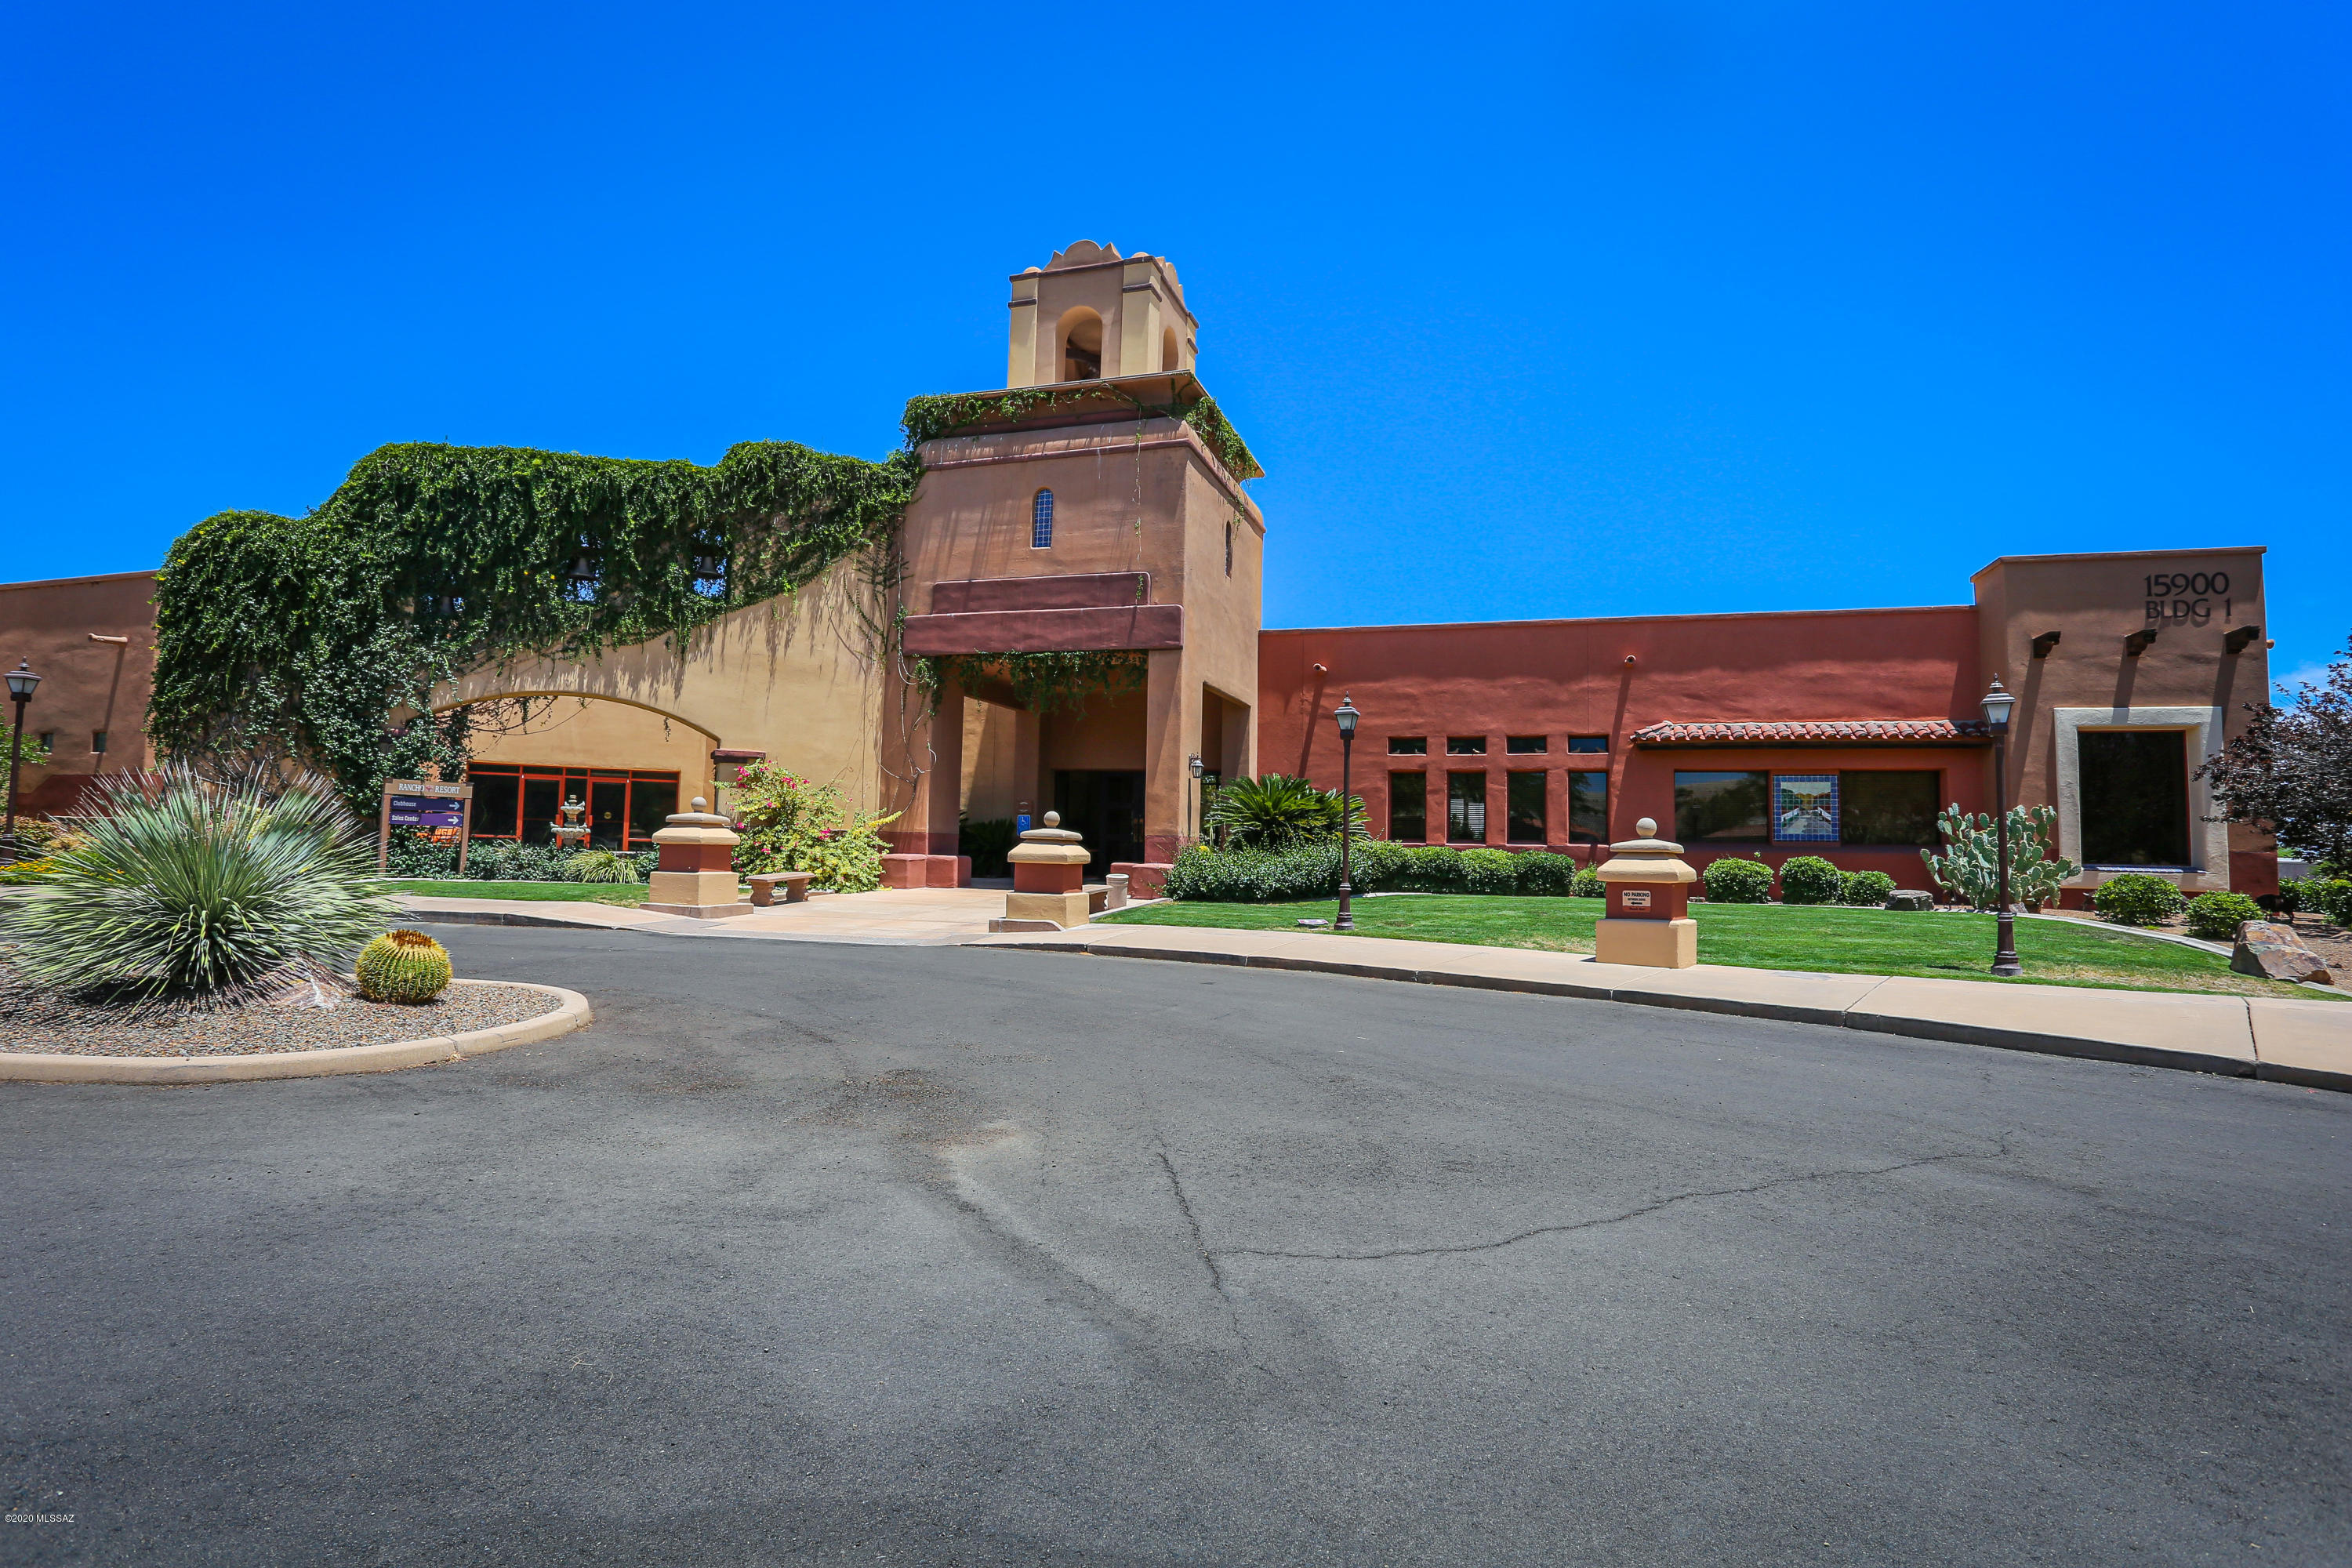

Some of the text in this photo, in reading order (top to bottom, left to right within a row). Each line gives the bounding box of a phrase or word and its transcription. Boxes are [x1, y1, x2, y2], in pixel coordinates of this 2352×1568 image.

[2144, 572, 2229, 597] 15900
[2146, 597, 2232, 619] BLDG 1
[399, 783, 460, 794] RANCHO RESORT
